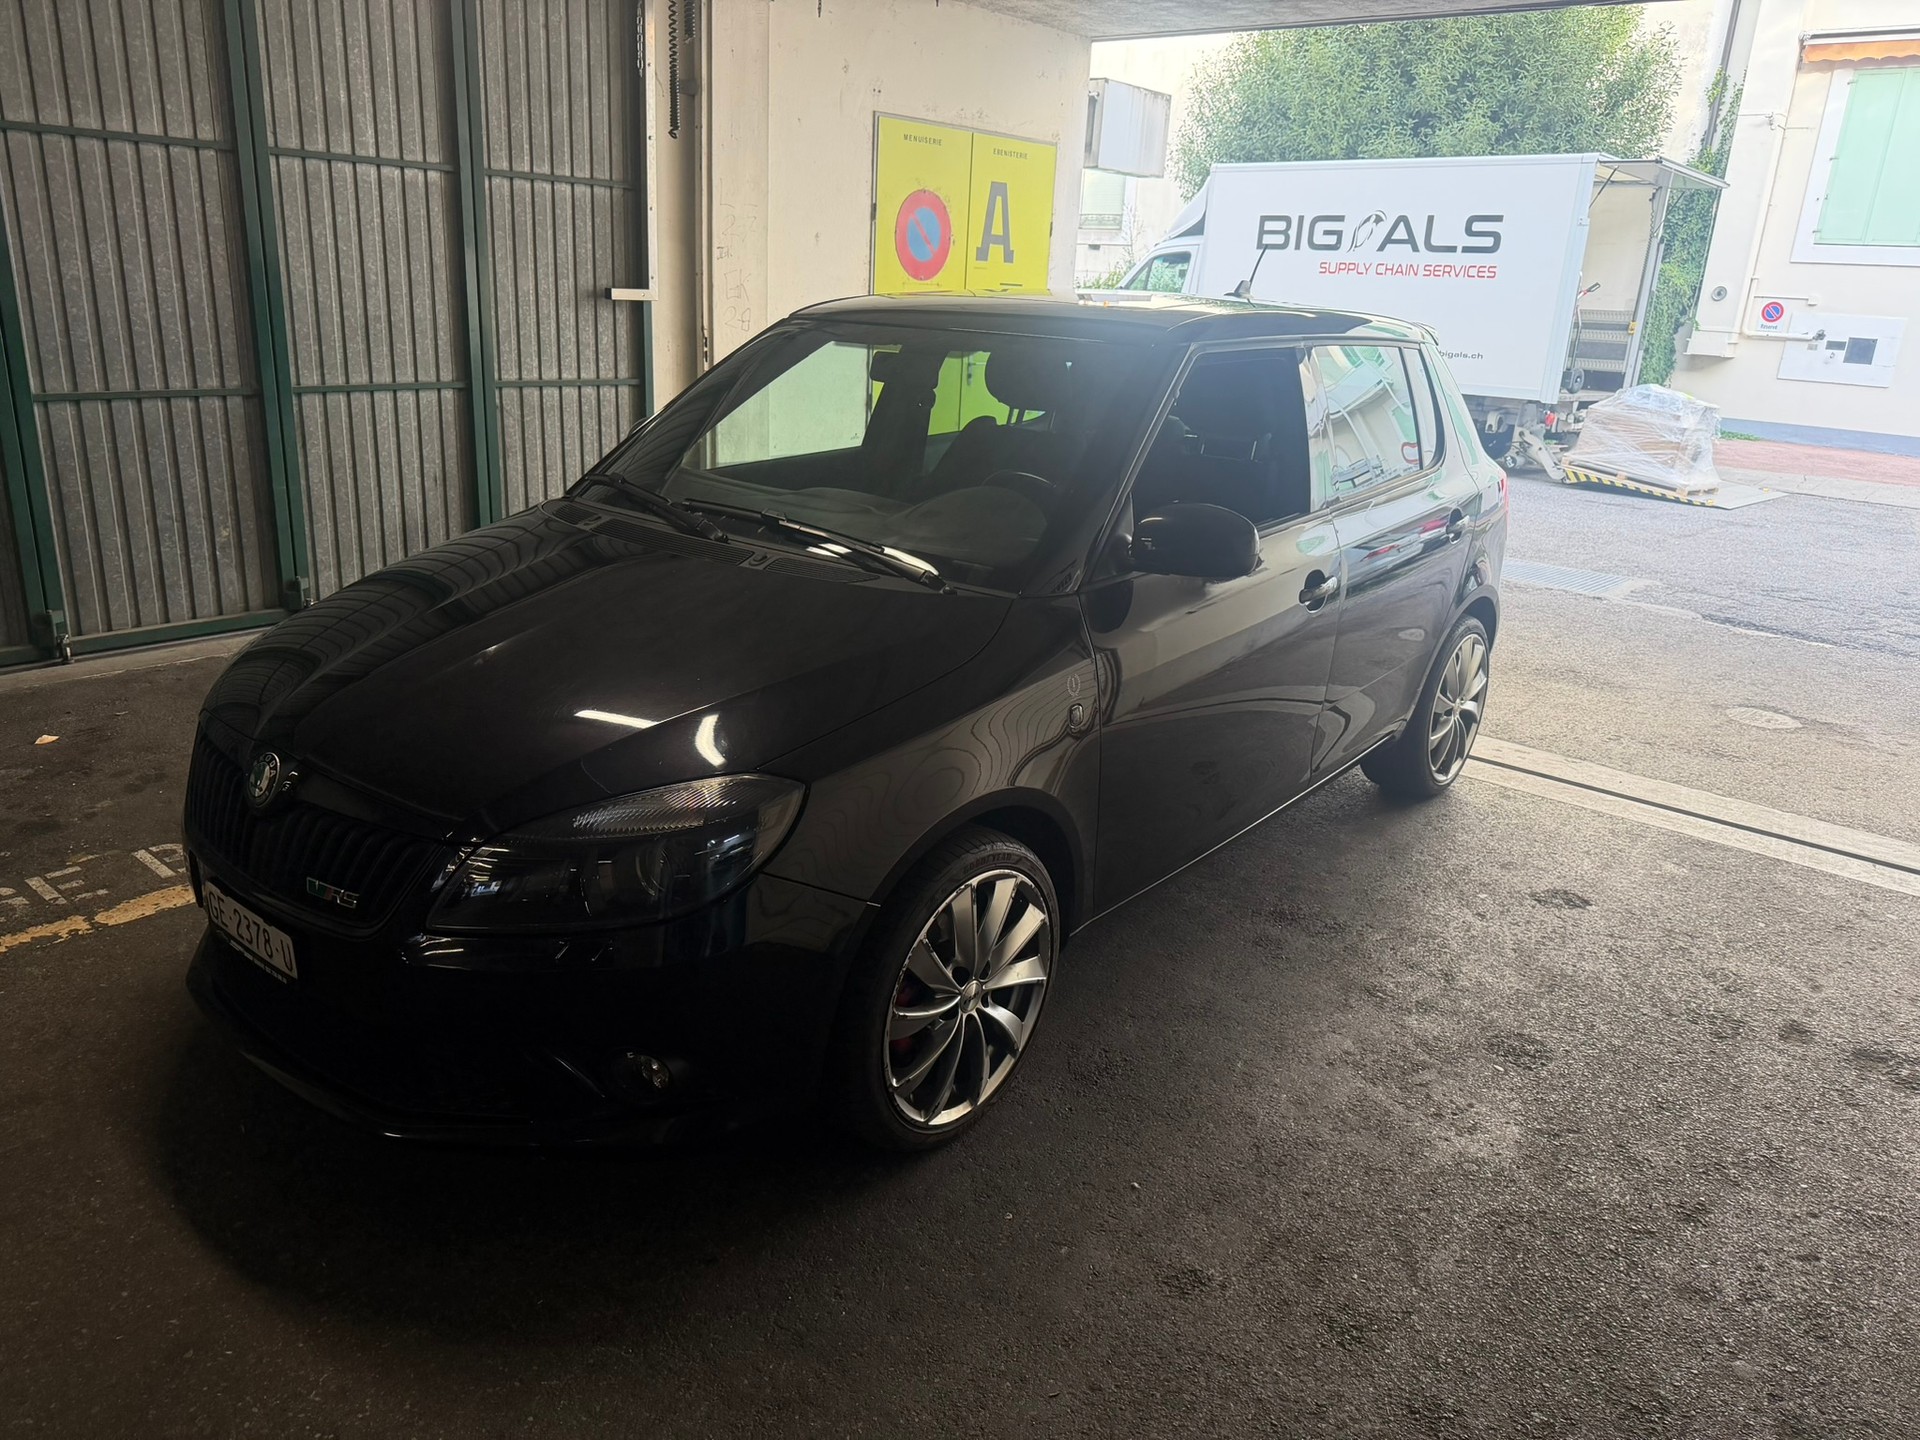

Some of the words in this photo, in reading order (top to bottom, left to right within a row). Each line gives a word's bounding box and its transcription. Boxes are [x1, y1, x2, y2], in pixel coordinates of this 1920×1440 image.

[903, 133, 942, 146] MENUISERIE
[993, 148, 1028, 160] EBENISTERIE
[975, 181, 1014, 263] A
[1319, 262, 1373, 275] SUPPLY
[1375, 263, 1420, 277] CHAIN
[1422, 264, 1497, 279] SERVICES
